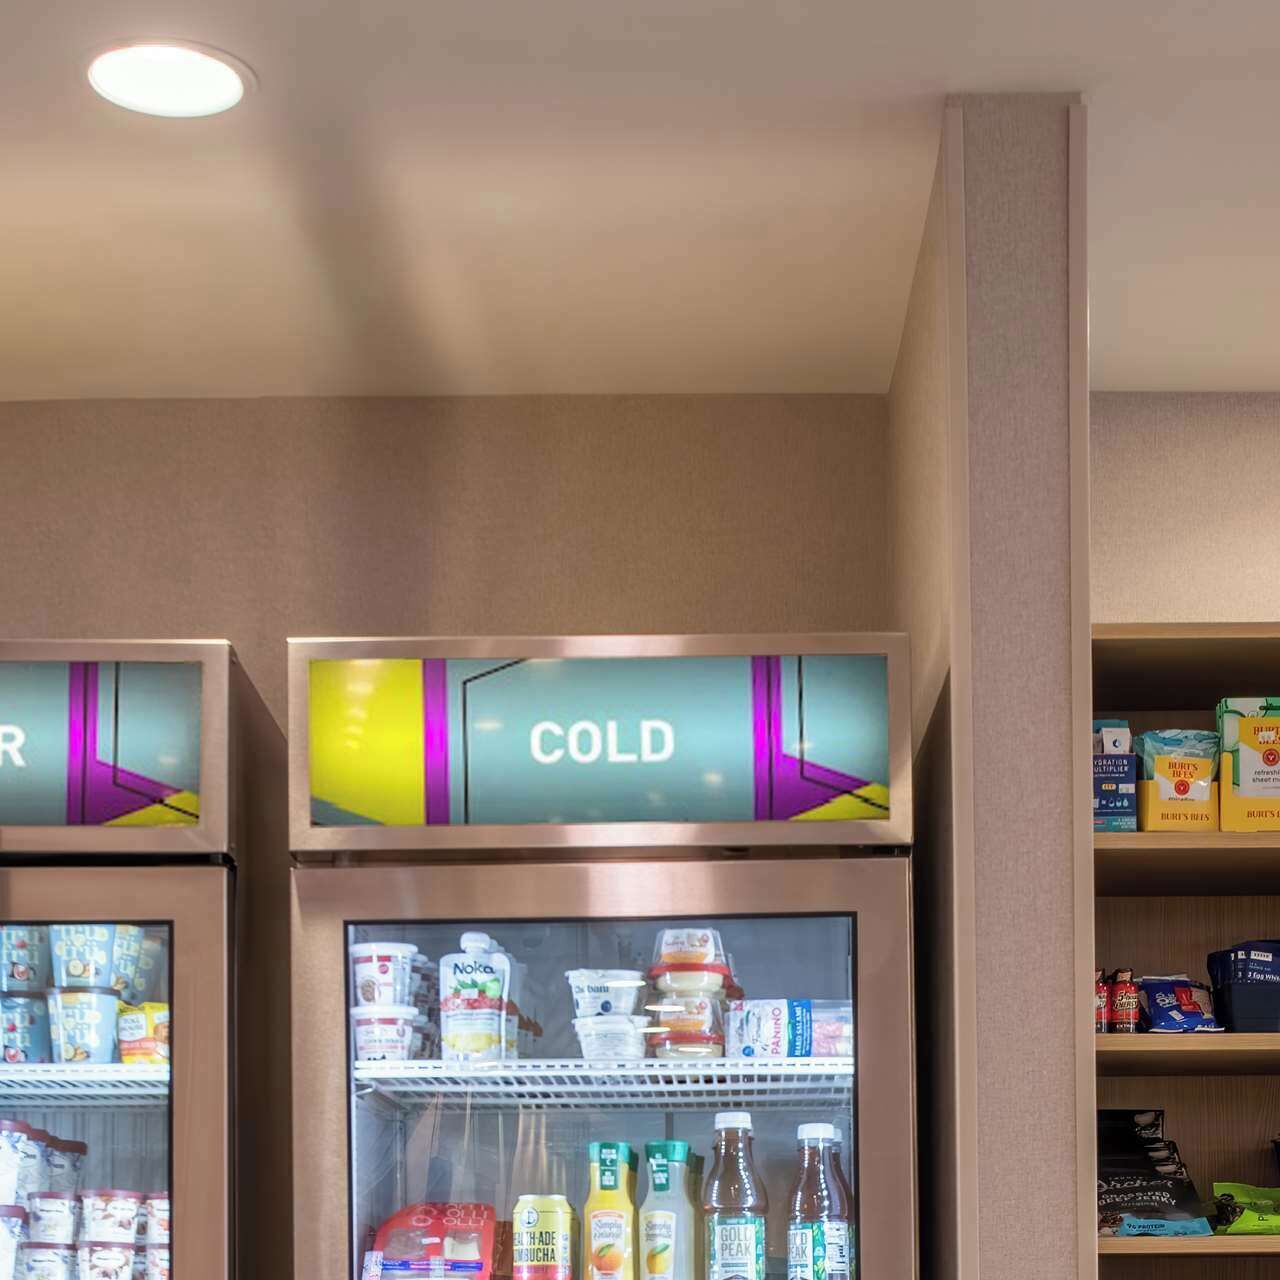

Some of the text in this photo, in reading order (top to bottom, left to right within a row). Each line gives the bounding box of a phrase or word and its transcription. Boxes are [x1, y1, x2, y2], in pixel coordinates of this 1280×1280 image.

[529, 720, 675, 764] COLD
[1168, 761, 1198, 771] BURT'S
[1172, 770, 1194, 779] BEES
[1160, 812, 1210, 821] BURT'S BEES
[1247, 810, 1275, 818] BURT'S
[453, 961, 497, 976] Noka
[1252, 972, 1264, 981] Egg
[771, 1007, 782, 1055] PANINO
[514, 1247, 556, 1263] OMBUCHA
[721, 1243, 752, 1257] PEAK
